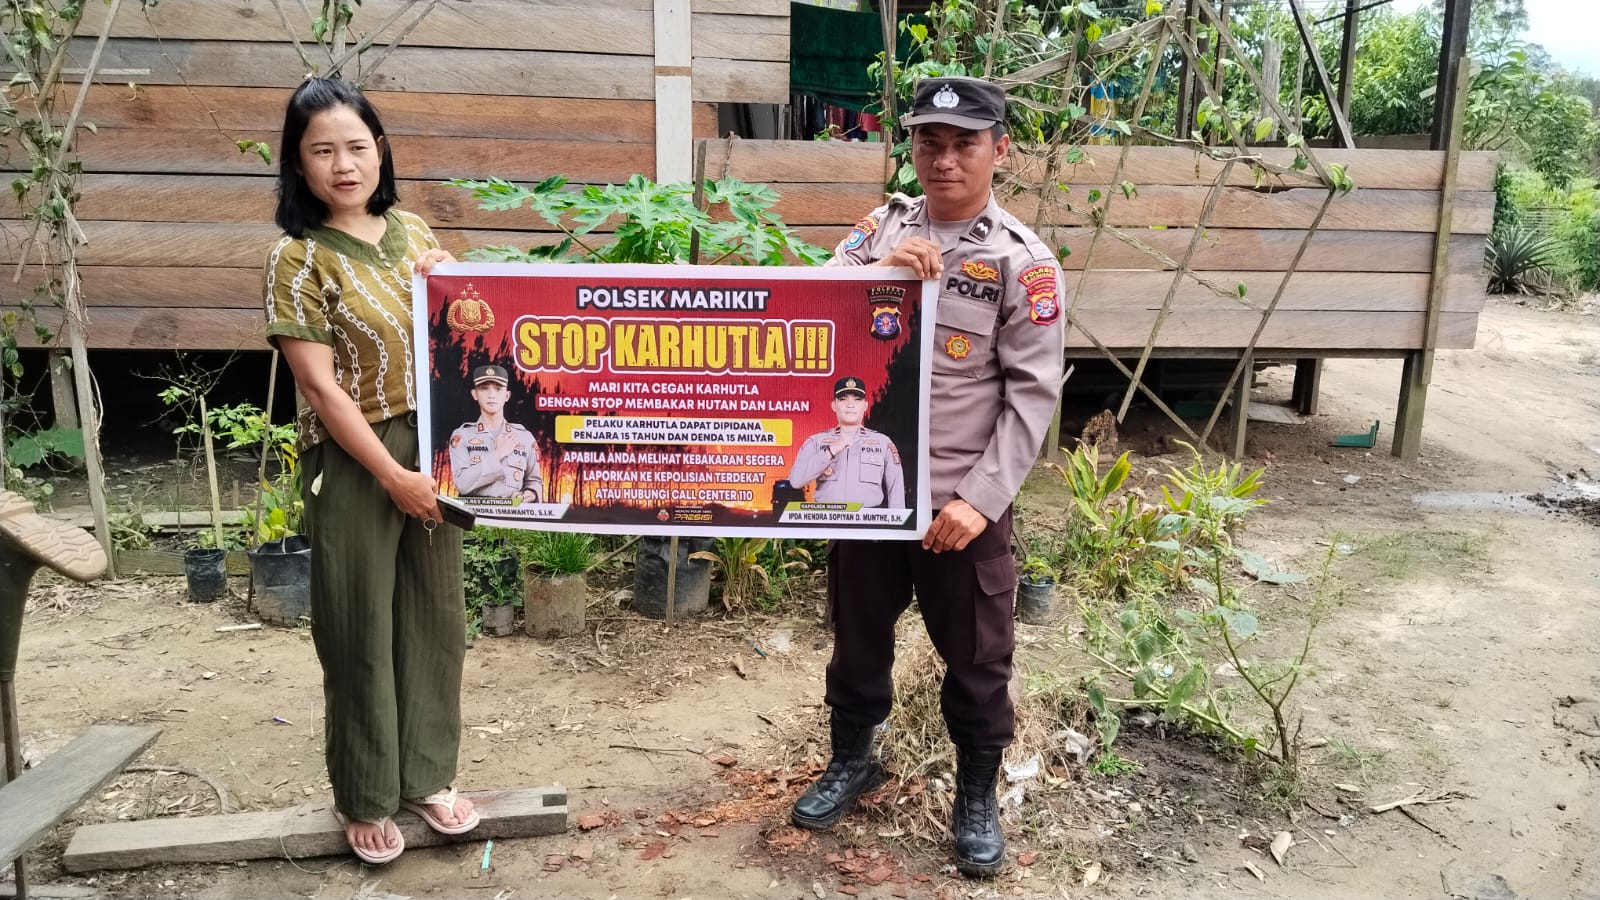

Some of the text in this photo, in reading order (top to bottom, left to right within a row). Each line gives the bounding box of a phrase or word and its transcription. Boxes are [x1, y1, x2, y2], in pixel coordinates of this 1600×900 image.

[946, 277, 1000, 303] POLRI
[578, 288, 769, 310] POLSEK MARIKIT
[519, 321, 829, 370] STOP KARHUTLA !!!
[588, 382, 759, 395] MARI KITA CEGAH KARHUTLA
[538, 397, 810, 412] DENGAN STOP MEMBAKAR HUTAN DAN LAHAN
[586, 419, 762, 431] PELAKU KARHUTLA DAPAT DIPIDANA
[574, 431, 774, 443] PENJARA 15 TAHUN DAN DENDA 15 MILYAR
[563, 451, 785, 466] APABILA ANDA MELIHAT KEBAKARAN SEGERA
[583, 470, 765, 483] LAPORKAN KE KEPOLISIAN TERDEKAT
[595, 488, 753, 501] ATAU HUBUNGI CALL CENTER 110
[495, 508, 537, 516] ISMAWANTO,
[674, 513, 712, 521] PRESISI
[788, 512, 802, 521] IPDA
[804, 512, 827, 521] HENDRA
[829, 513, 854, 521] SOPIYAN
[863, 514, 889, 523] MUNTHE,
